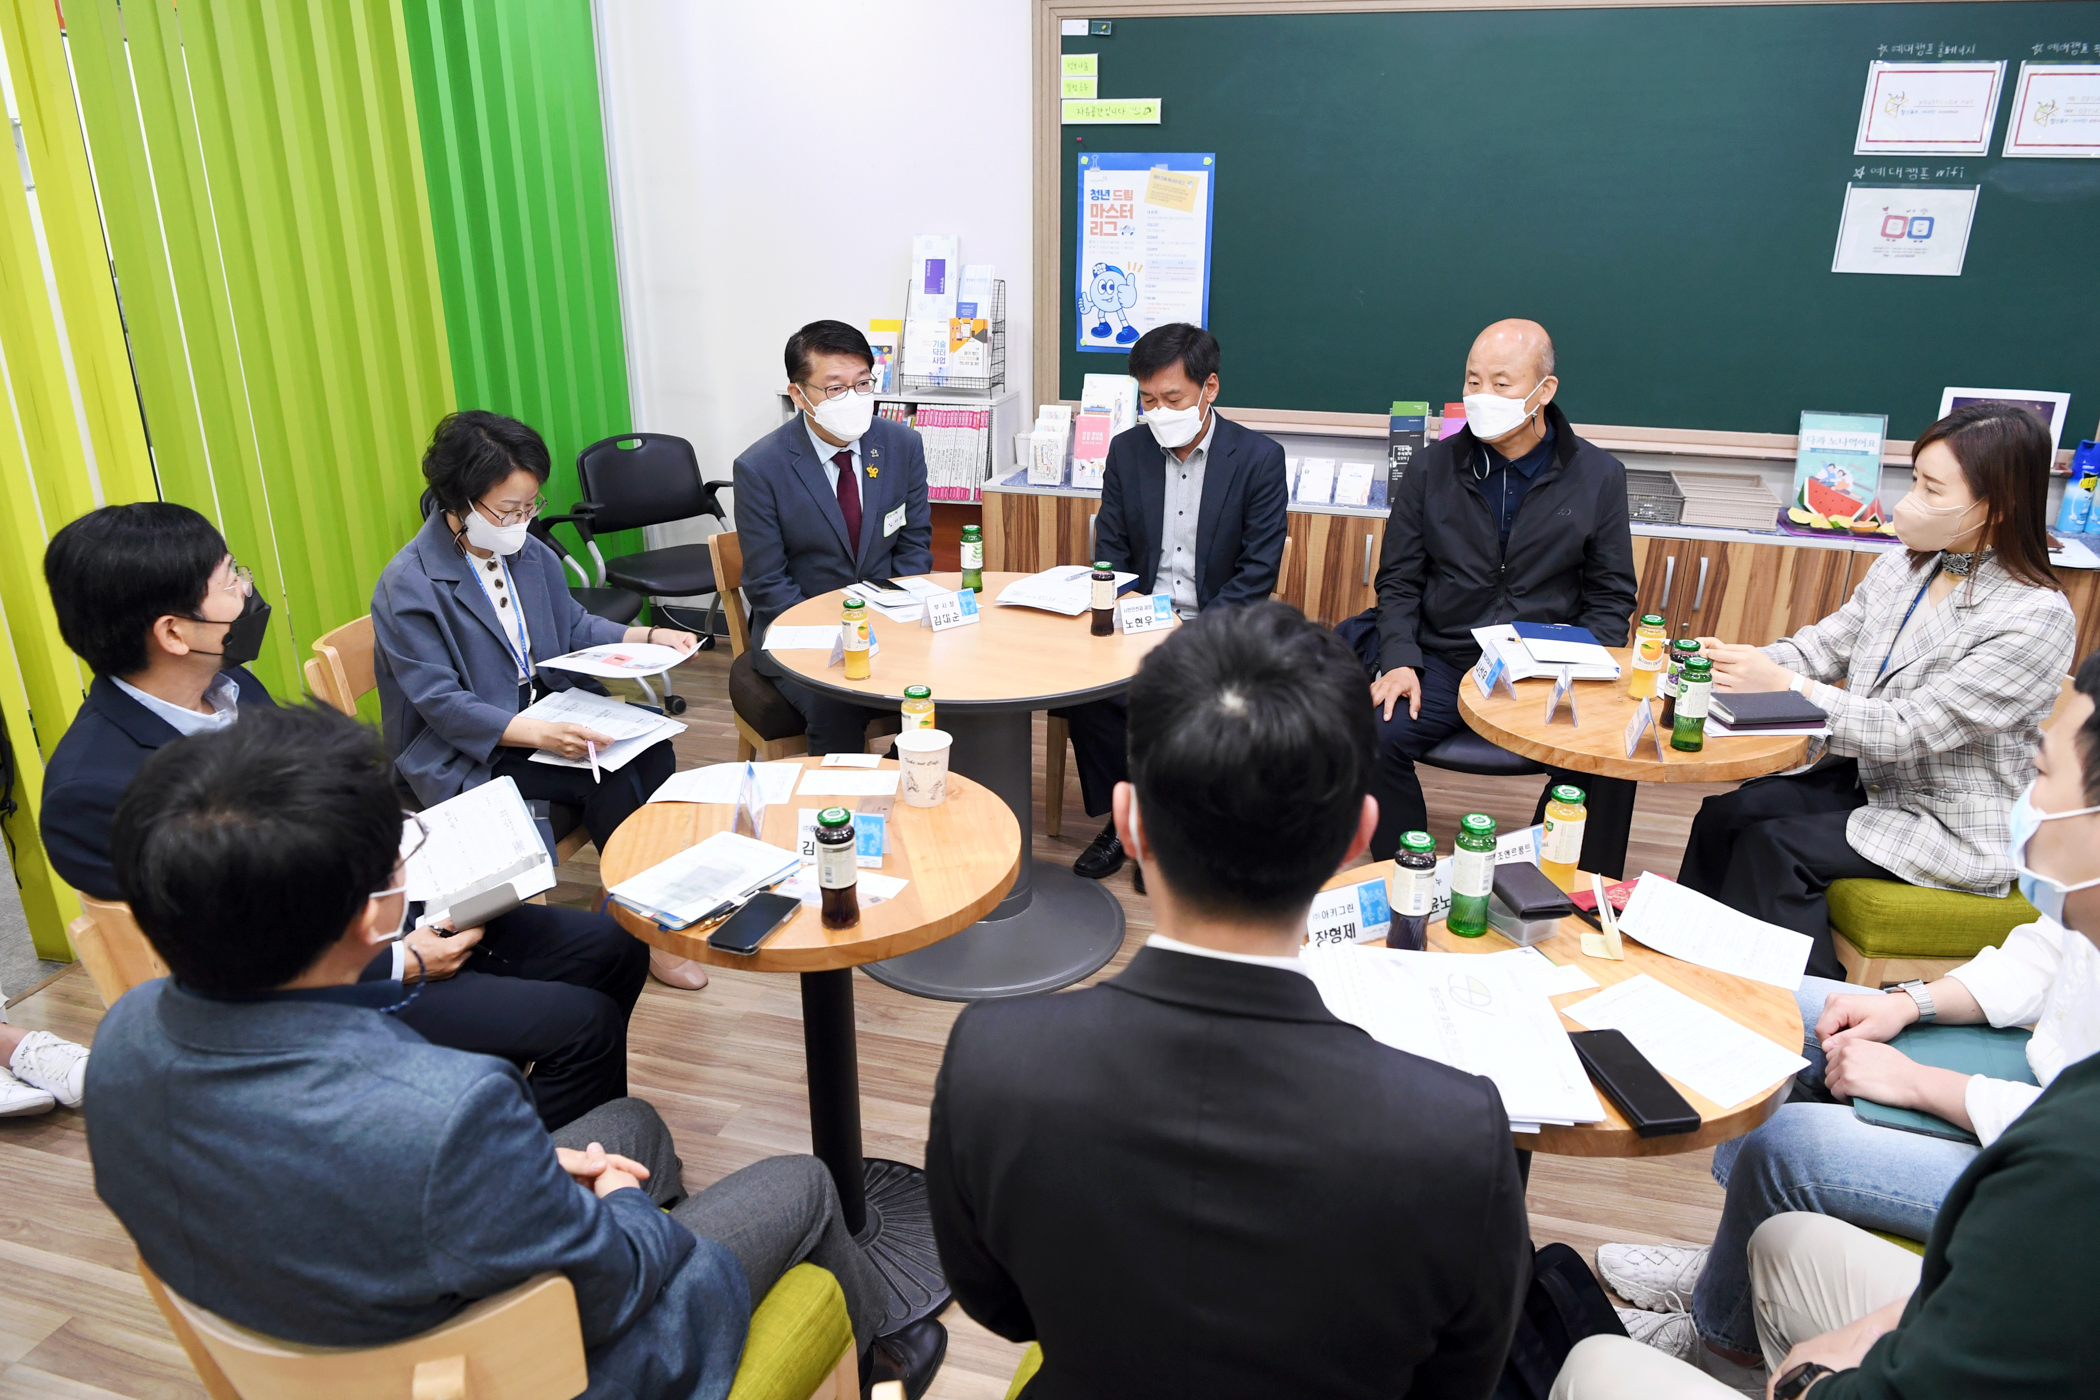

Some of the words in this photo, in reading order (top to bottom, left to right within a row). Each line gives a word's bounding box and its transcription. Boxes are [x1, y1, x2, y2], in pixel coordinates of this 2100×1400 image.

[1090, 189, 1110, 201] 청년
[1112, 189, 1133, 201] 드림
[1090, 203, 1133, 219] 마스터
[1090, 221, 1118, 236] 리그
[932, 340, 946, 348] 기술
[932, 348, 946, 356] 닥터
[932, 357, 946, 365] 사업
[1806, 435, 1826, 446] 다과
[1125, 615, 1153, 629] 노현우
